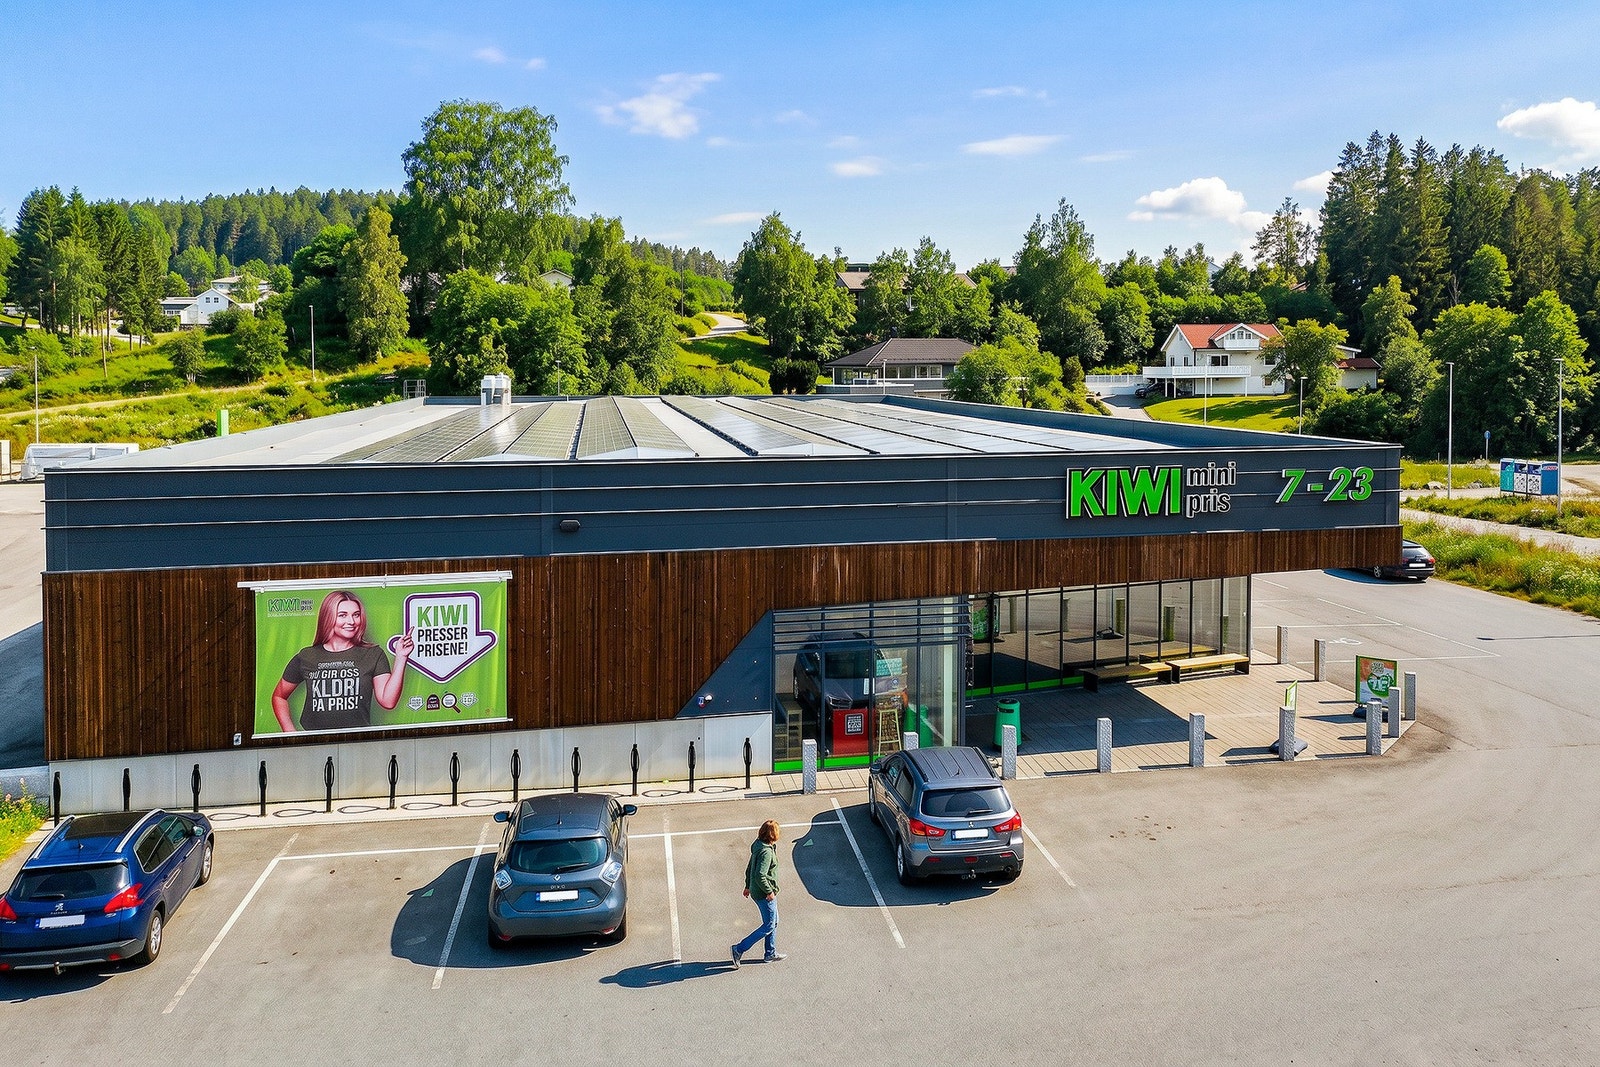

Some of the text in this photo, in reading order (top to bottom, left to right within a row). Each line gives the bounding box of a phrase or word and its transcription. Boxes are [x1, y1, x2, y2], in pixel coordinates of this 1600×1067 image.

[1186, 461, 1237, 487] mini
[1275, 468, 1306, 503] 7
[1323, 466, 1374, 502] 23
[1066, 465, 1183, 519] KIWI
[1186, 488, 1231, 519] pris
[267, 598, 300, 612] KIWI
[417, 604, 468, 627] KIWI
[417, 627, 468, 642] PRESSER
[417, 642, 468, 657] PRISENE!
[321, 669, 338, 679] GIR
[340, 668, 360, 678] OSS
